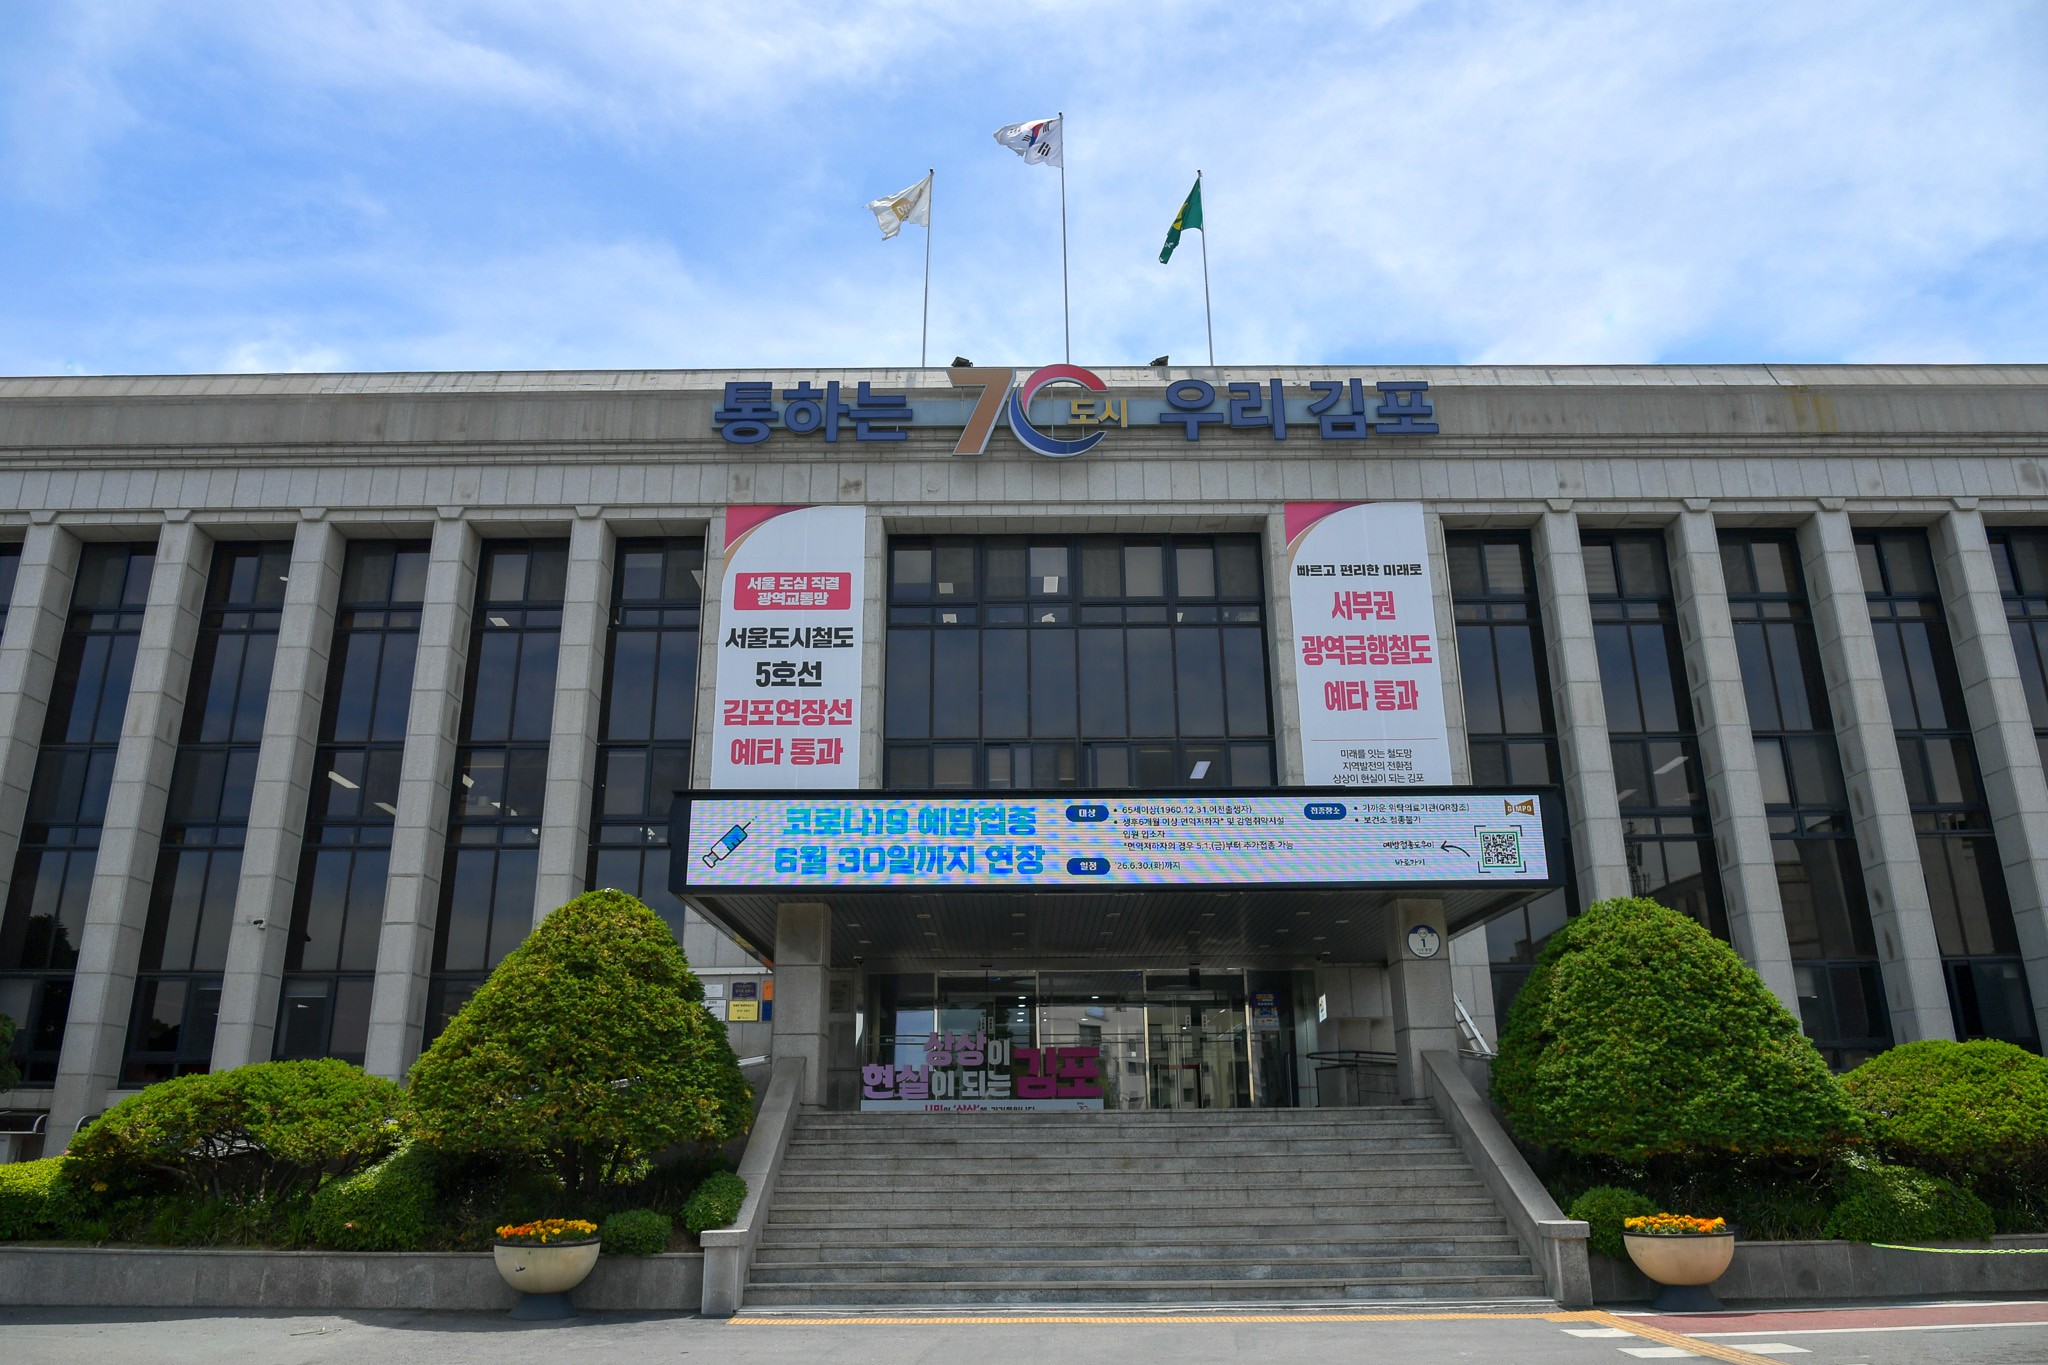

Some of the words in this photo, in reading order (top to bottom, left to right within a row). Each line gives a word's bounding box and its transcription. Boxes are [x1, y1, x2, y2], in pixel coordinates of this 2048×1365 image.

[714, 380, 914, 443] 통하는
[1068, 399, 1128, 427] 도시
[1160, 378, 1287, 441] 우리
[1308, 377, 1440, 440] 김포
[1297, 564, 1336, 576] 빠르고
[1340, 564, 1379, 576] 편리한
[1383, 563, 1422, 576] 미래로
[747, 576, 776, 590] 서울
[779, 576, 807, 590] 도심
[811, 576, 840, 590] 직결
[757, 592, 829, 606] 광역교통망
[1332, 591, 1396, 620] 서부권
[725, 627, 854, 649] 서울도시철도
[1301, 634, 1433, 666] 광역급행철도
[755, 661, 822, 687] 5호선
[1324, 680, 1369, 711] 예타
[1374, 679, 1419, 711] 통과
[723, 698, 853, 726] 김포연장선
[730, 738, 784, 765] 예타
[790, 738, 844, 765] 통과
[1340, 748, 1366, 759] 미래를
[1367, 748, 1385, 759] 잇는
[1387, 748, 1413, 759] 철도망
[1343, 761, 1385, 771] 지역발전의
[1387, 760, 1413, 771] 전환점
[1332, 773, 1359, 784] 상상이
[1360, 773, 1387, 784] 현실이
[1388, 773, 1406, 783] 되는
[1407, 773, 1425, 783] 김포
[1078, 808, 1096, 818] 대상
[1362, 803, 1387, 813] 가까운
[782, 808, 909, 836] 코로나19
[917, 807, 1037, 836] 예방접종
[1122, 817, 1160, 827] 생후6개월
[1162, 817, 1178, 827] 이상
[1226, 817, 1234, 826] 및
[1236, 816, 1285, 826] 감염취약시설
[1364, 815, 1388, 824] 보건소
[1389, 815, 1421, 825] 접종불가
[1141, 830, 1166, 839] 입소자
[1179, 841, 1194, 851] 경우
[1243, 841, 1275, 850] 추가접종
[1277, 841, 1294, 850] 가능
[1382, 840, 1435, 850] 예방접종도우미
[774, 845, 827, 875] 6월
[837, 844, 975, 875] 30일까지
[984, 844, 1046, 875] 연장
[1079, 861, 1097, 871] 일정
[1394, 858, 1426, 867] 바로가기
[924, 1031, 1010, 1067] 상상이
[861, 1062, 954, 1101] 현실이
[961, 1070, 1012, 1097] 되는
[1014, 1046, 1104, 1099] 김포
